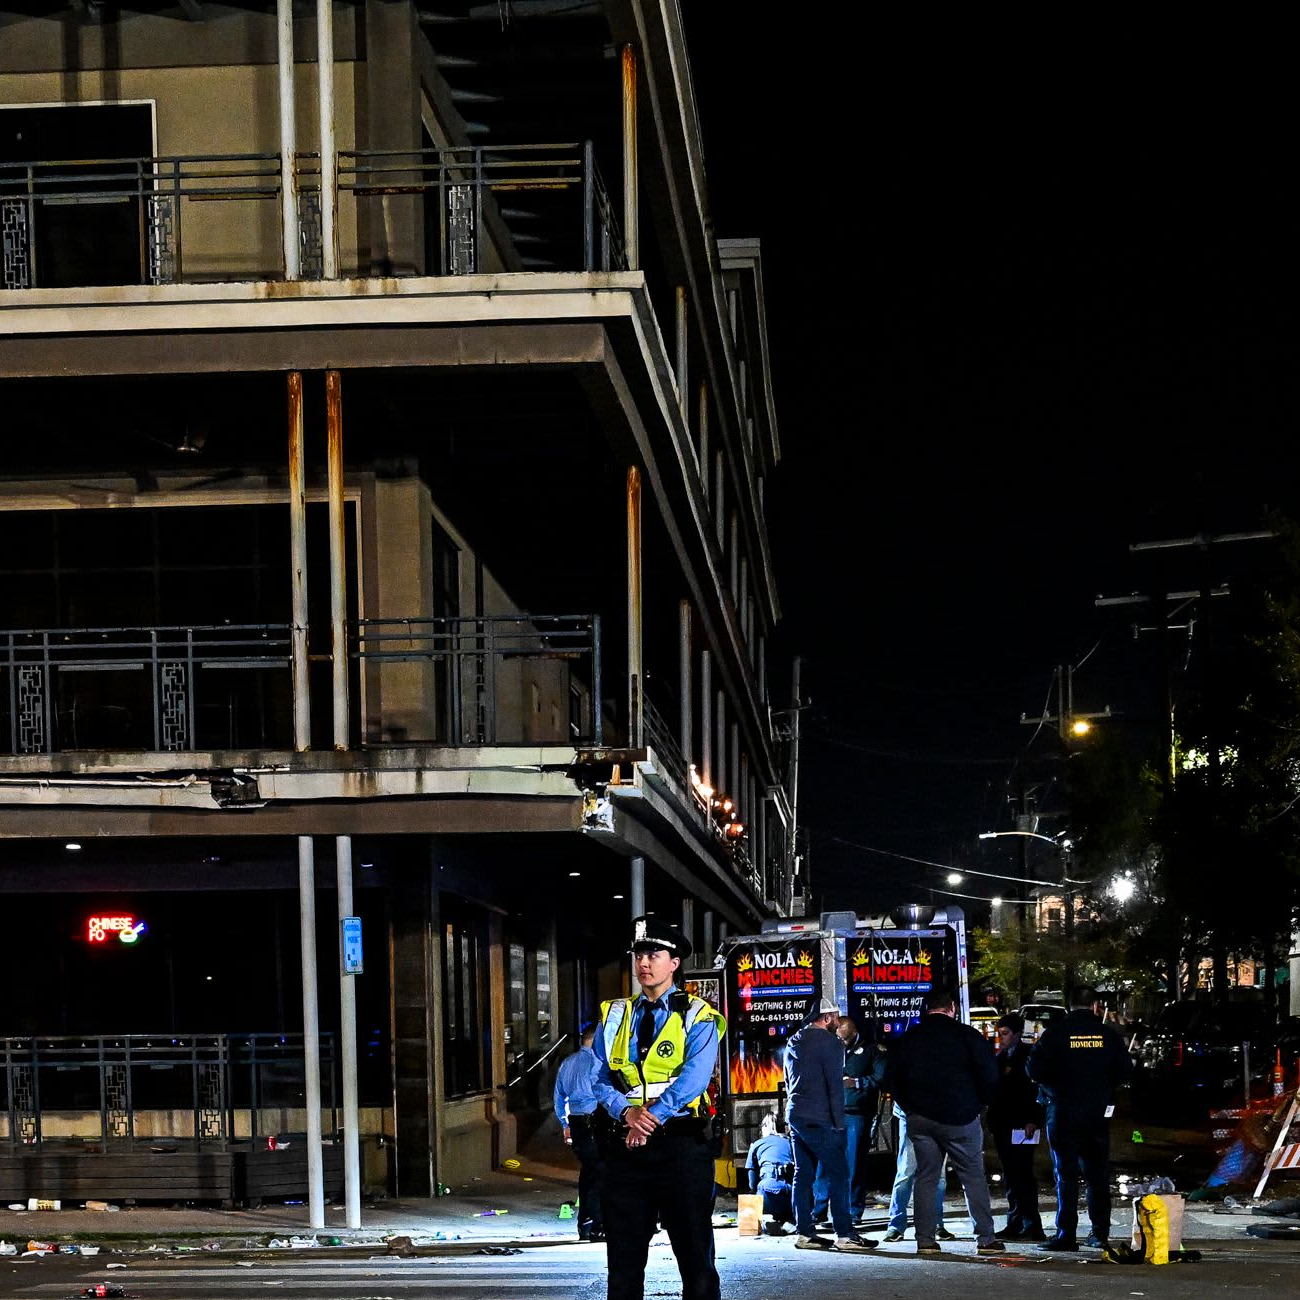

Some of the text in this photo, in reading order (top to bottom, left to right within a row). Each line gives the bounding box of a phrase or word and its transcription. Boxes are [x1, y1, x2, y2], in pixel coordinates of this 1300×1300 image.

[88, 917, 133, 930] CHINESE
[754, 952, 797, 969] NOLA
[868, 947, 914, 965] NOLA
[737, 968, 815, 987] MUNCHIES
[745, 1000, 807, 1011] EVERYTHING IS HOT
[901, 998, 908, 1006] IS
[910, 997, 924, 1006] HOT
[750, 1013, 804, 1022] 504-841-9039
[1070, 1040, 1104, 1048] HOMICIDE
